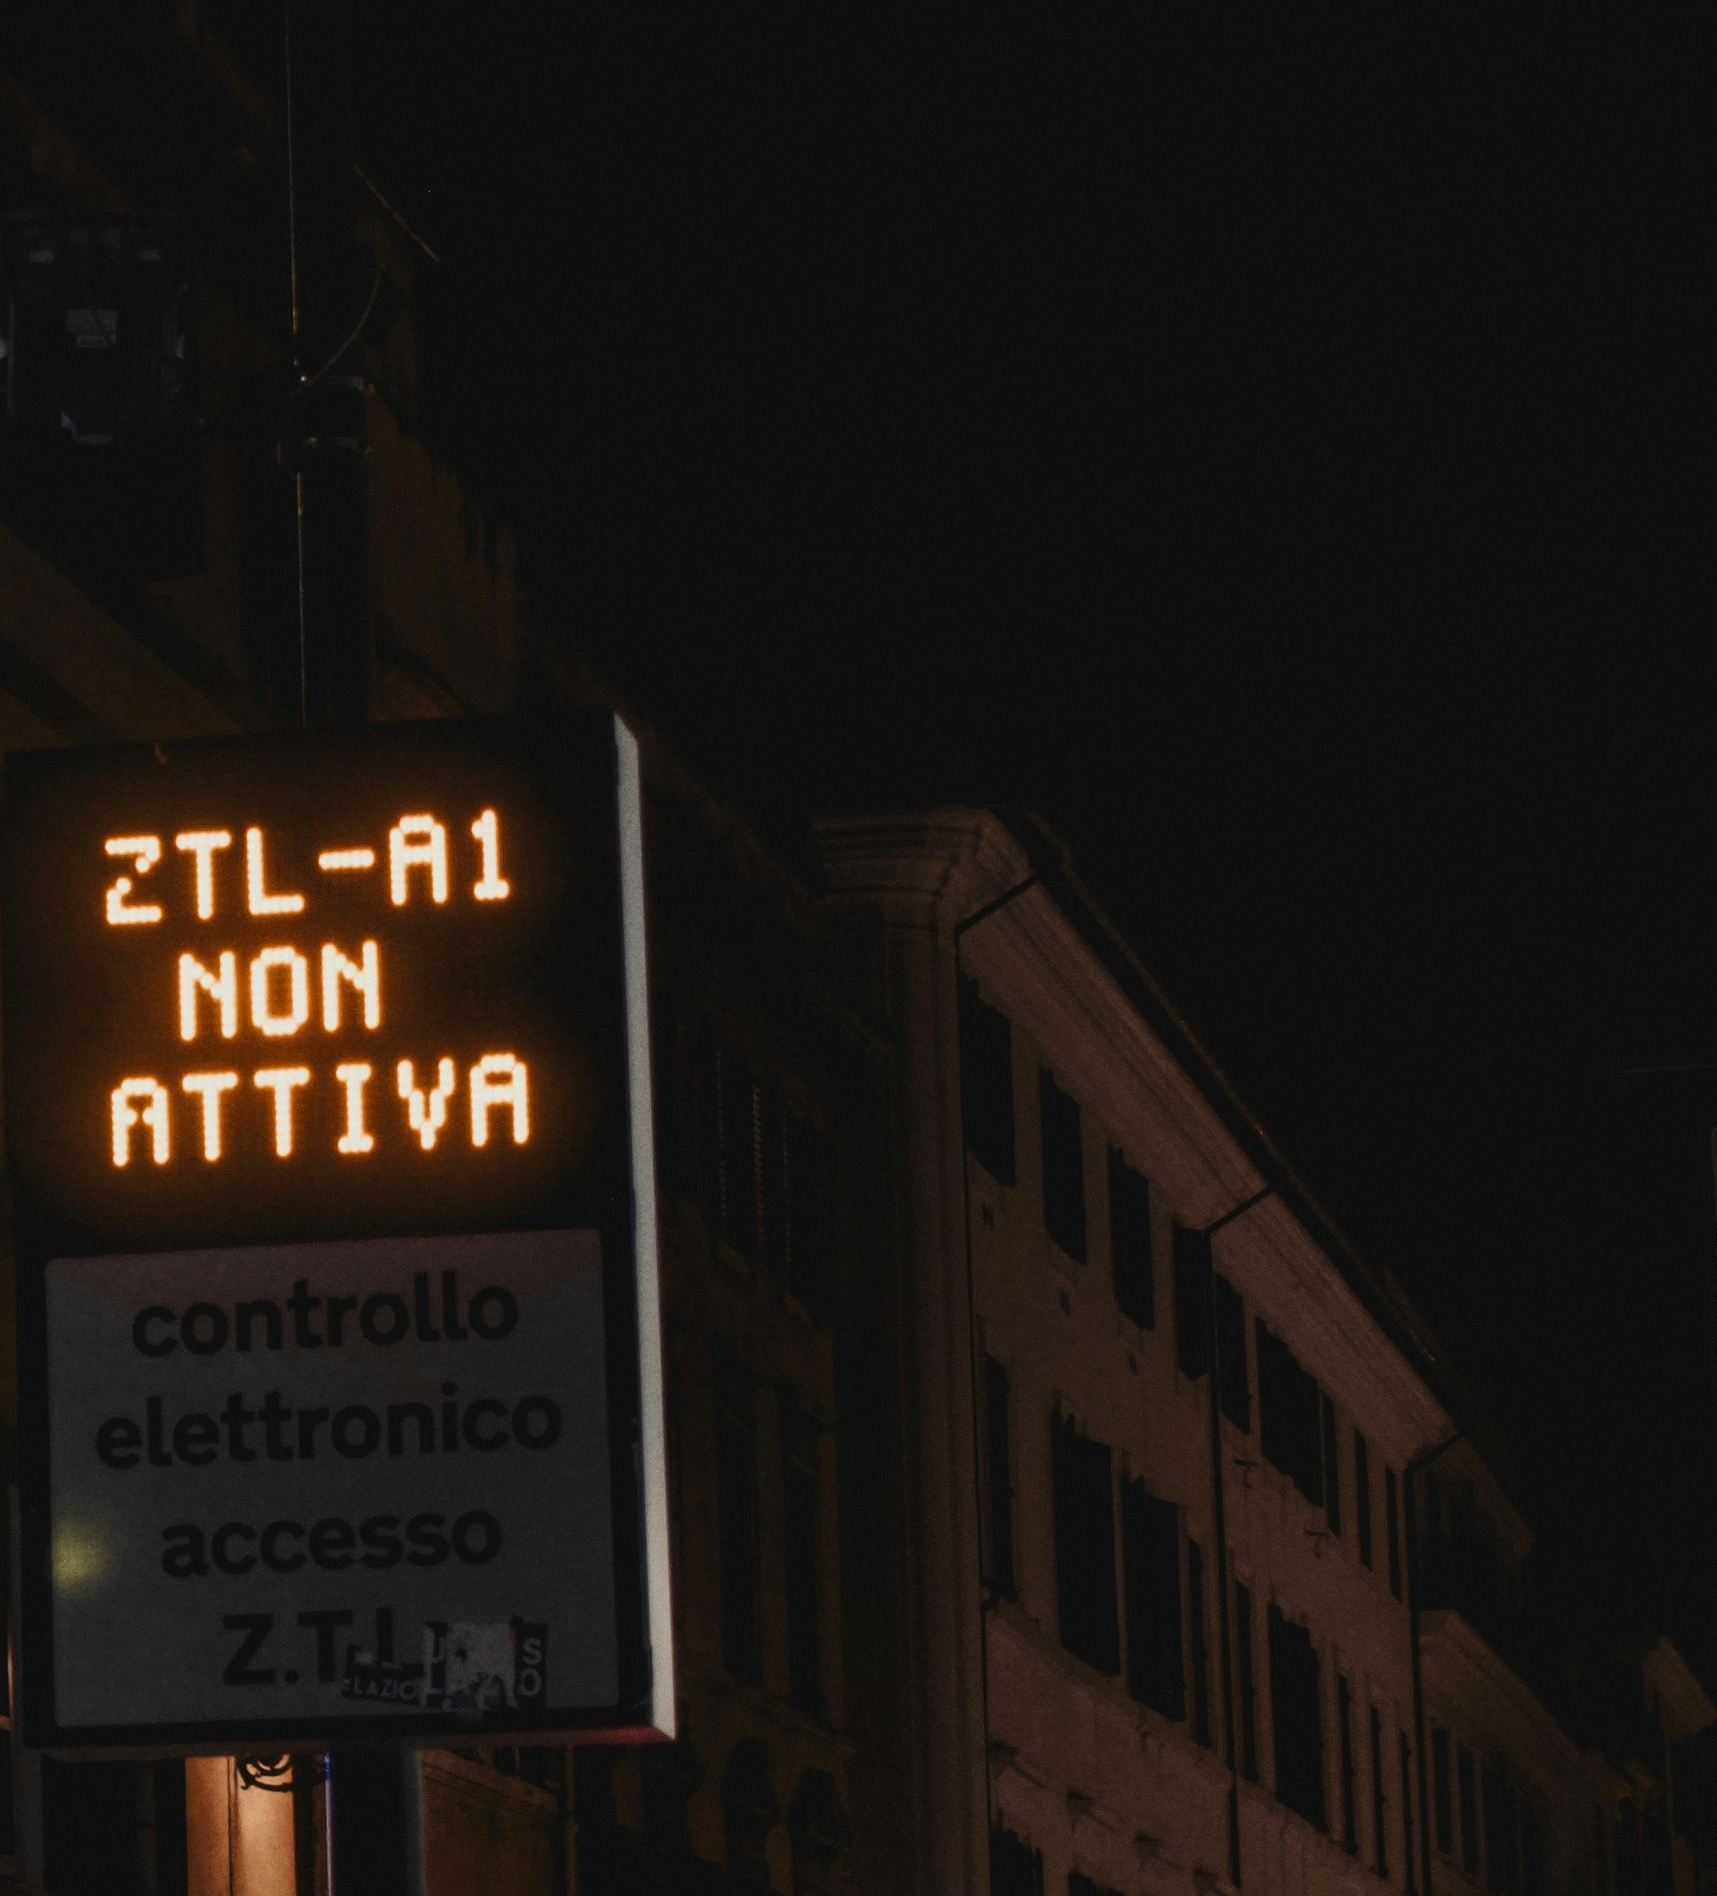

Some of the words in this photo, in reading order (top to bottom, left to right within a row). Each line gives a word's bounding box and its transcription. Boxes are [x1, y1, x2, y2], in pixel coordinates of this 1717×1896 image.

[104, 808, 511, 926] ZTL-A1
[178, 939, 381, 1042] NON
[110, 1051, 531, 1168] ATTIVA
[131, 1270, 519, 1358] controllo
[95, 1382, 563, 1469] elettronico
[160, 1509, 503, 1578] accesso
